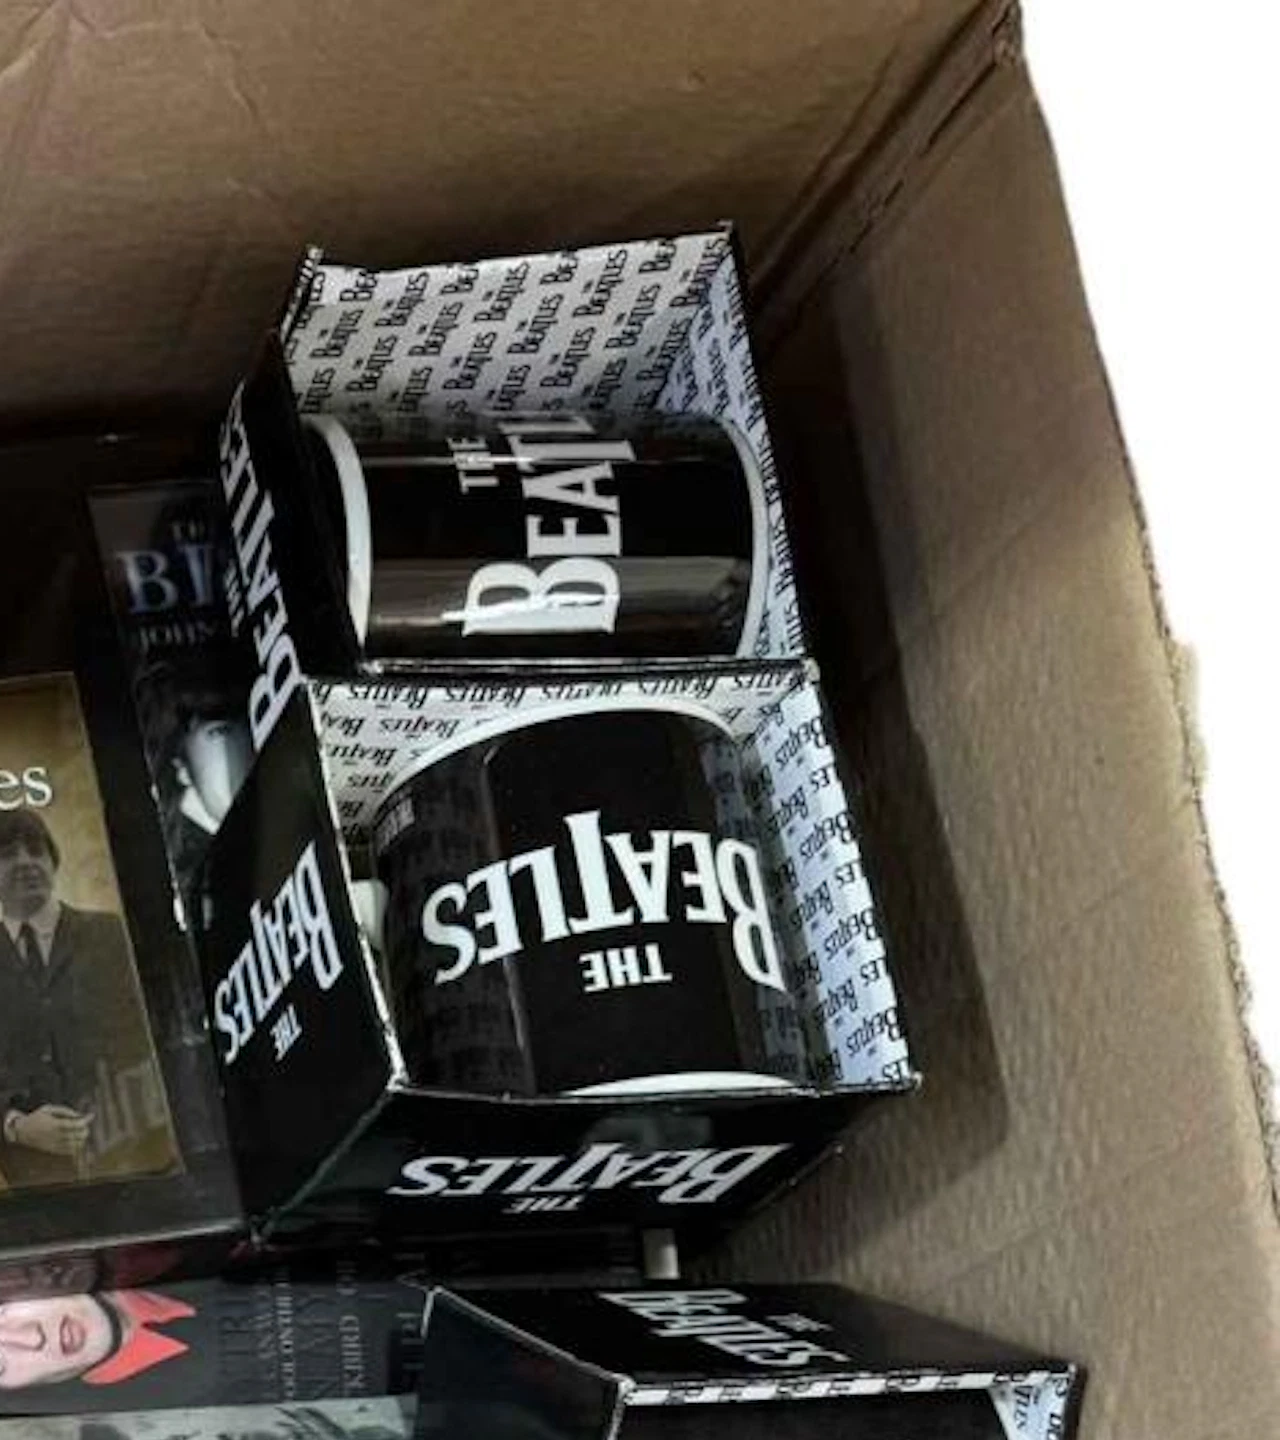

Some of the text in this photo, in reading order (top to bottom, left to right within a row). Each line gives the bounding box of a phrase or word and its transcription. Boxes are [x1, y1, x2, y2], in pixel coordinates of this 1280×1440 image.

[446, 435, 499, 494] THE
[421, 810, 788, 998] BEATLES
[211, 840, 343, 1064] BEATLES
[578, 943, 673, 993] THE
[272, 1006, 302, 1061] THE
[387, 1143, 793, 1203] BEATLES
[598, 1288, 852, 1367] BEATLES
